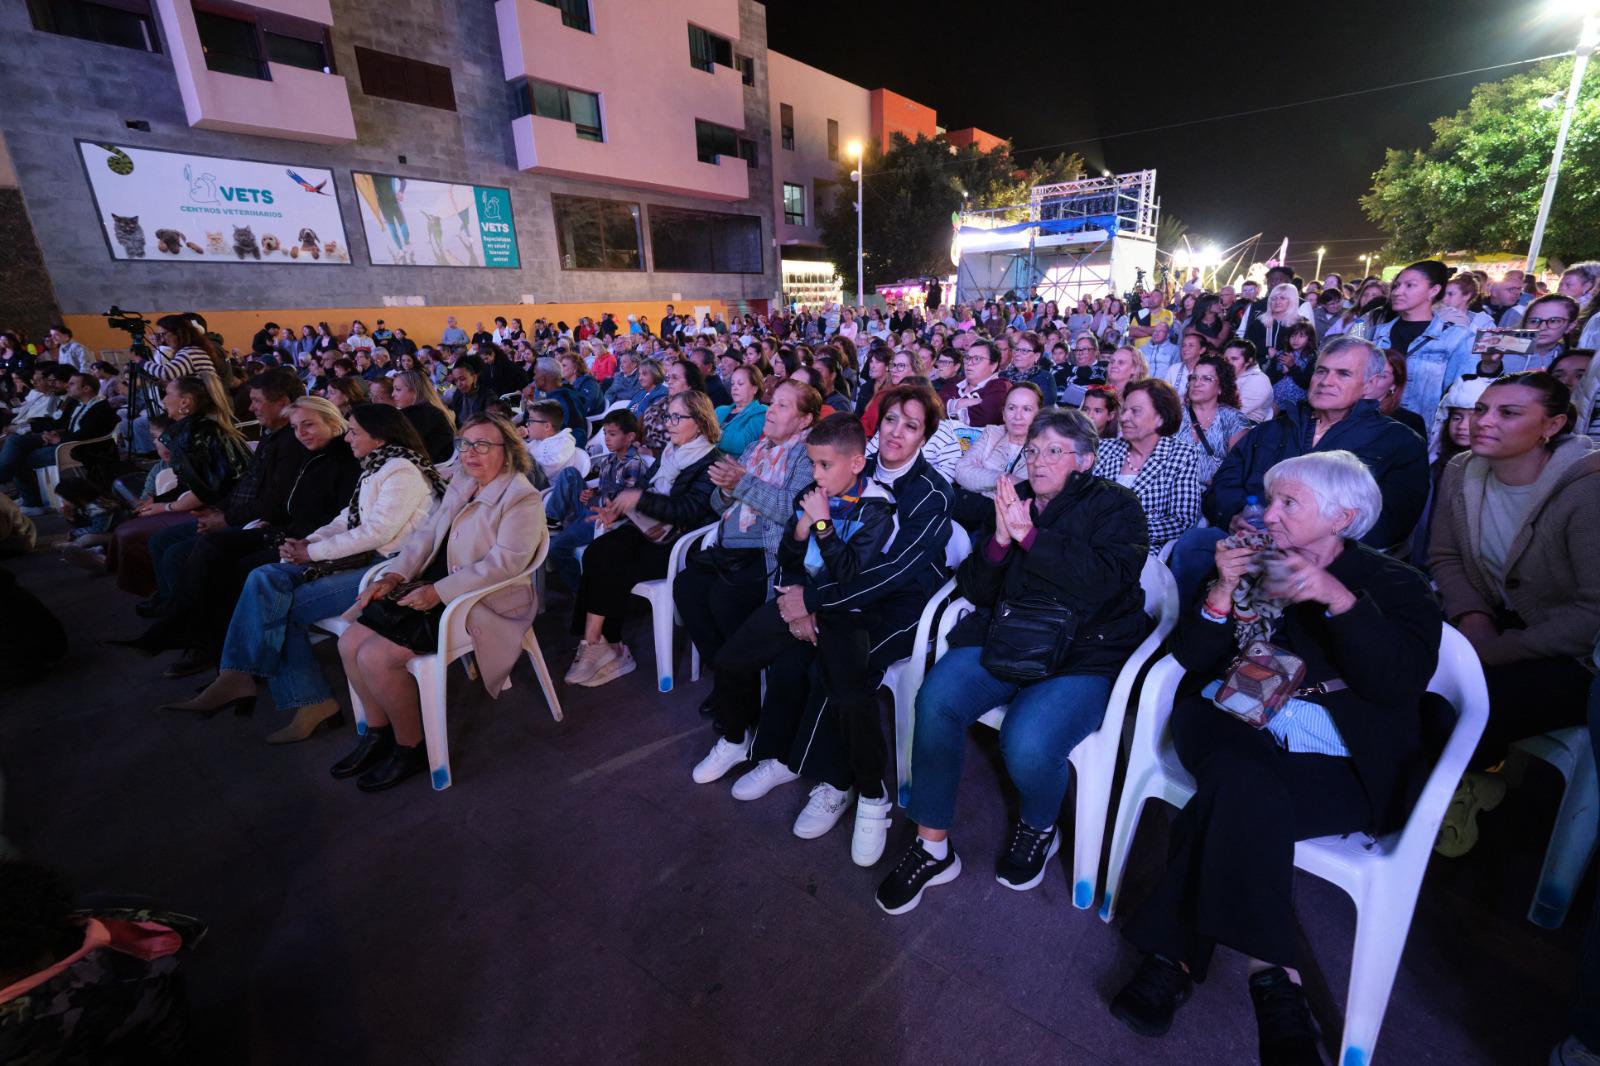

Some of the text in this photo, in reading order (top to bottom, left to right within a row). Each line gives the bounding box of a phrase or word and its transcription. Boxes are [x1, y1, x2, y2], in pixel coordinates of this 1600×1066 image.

[219, 185, 274, 204] VETS
[180, 205, 283, 218] CENTROS VETERINARIOS
[481, 222, 509, 233] VETS
